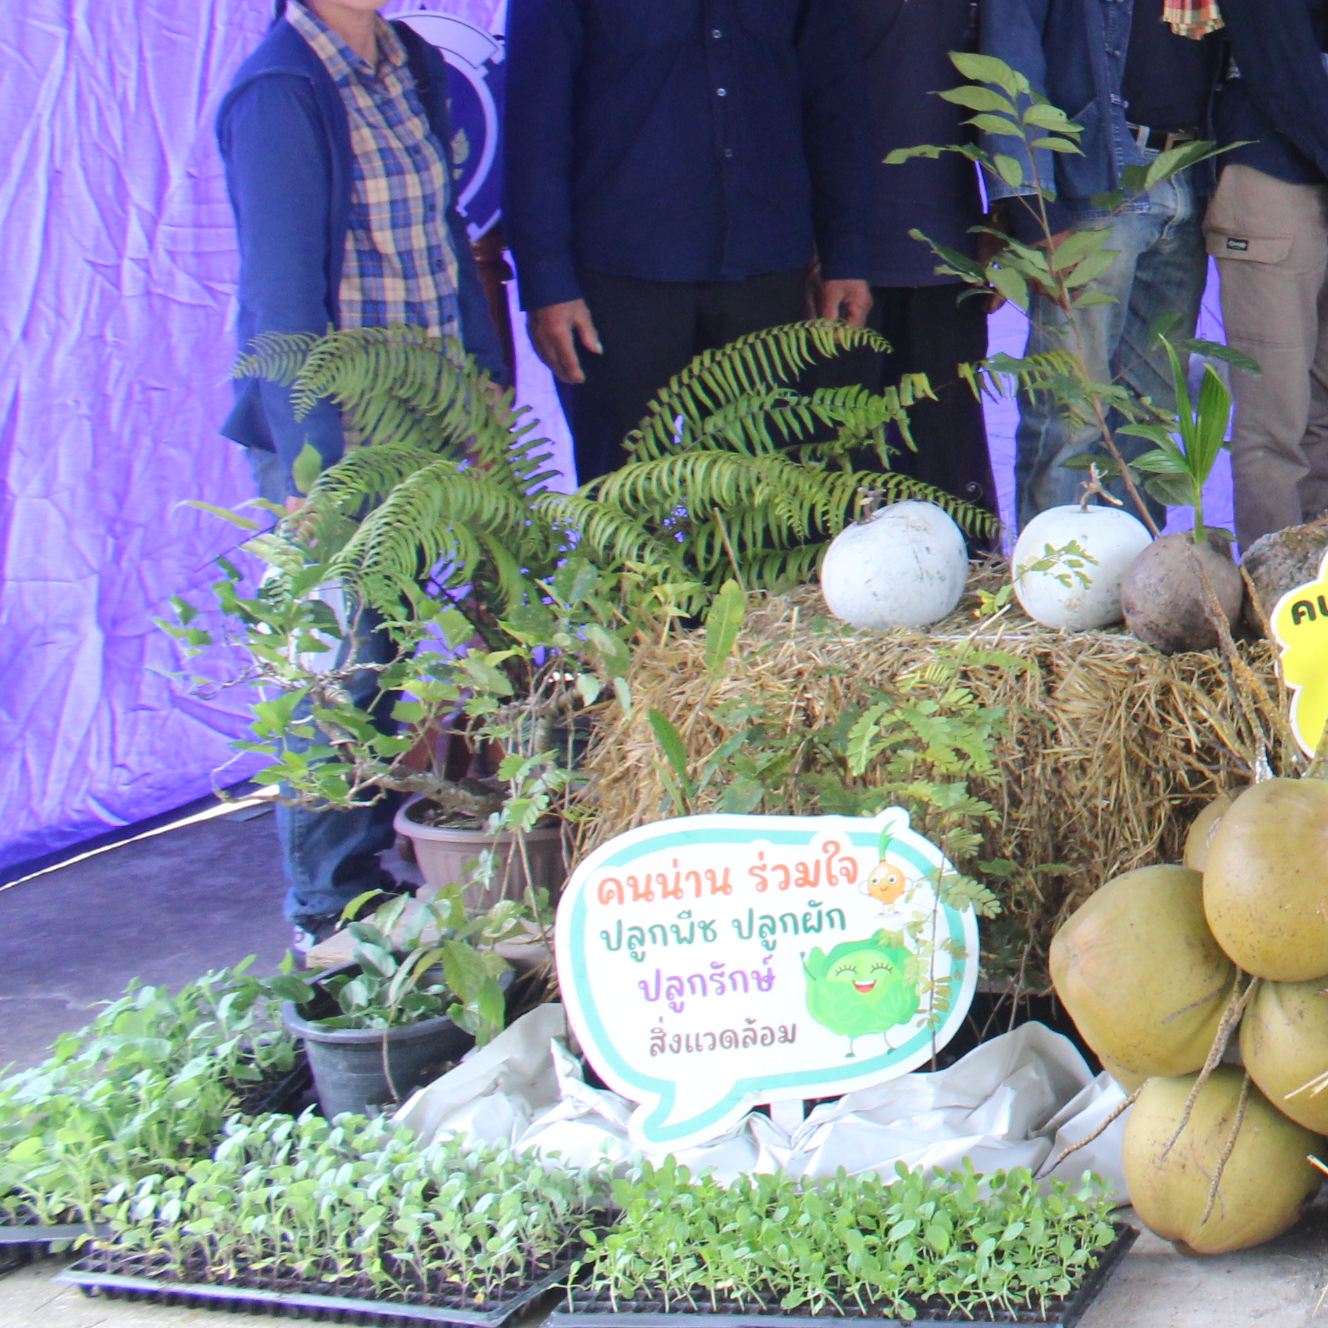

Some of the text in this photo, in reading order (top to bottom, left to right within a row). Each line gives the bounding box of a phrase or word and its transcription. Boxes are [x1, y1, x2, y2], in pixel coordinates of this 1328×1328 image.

[596, 839, 859, 906] คนน่าน ร่วมใจ
[600, 899, 847, 963] ปลูกพืช ปลูกผัก
[638, 954, 776, 1013] ปลูกรักษ์
[648, 1016, 798, 1058] สิ่งแวดล้อม
